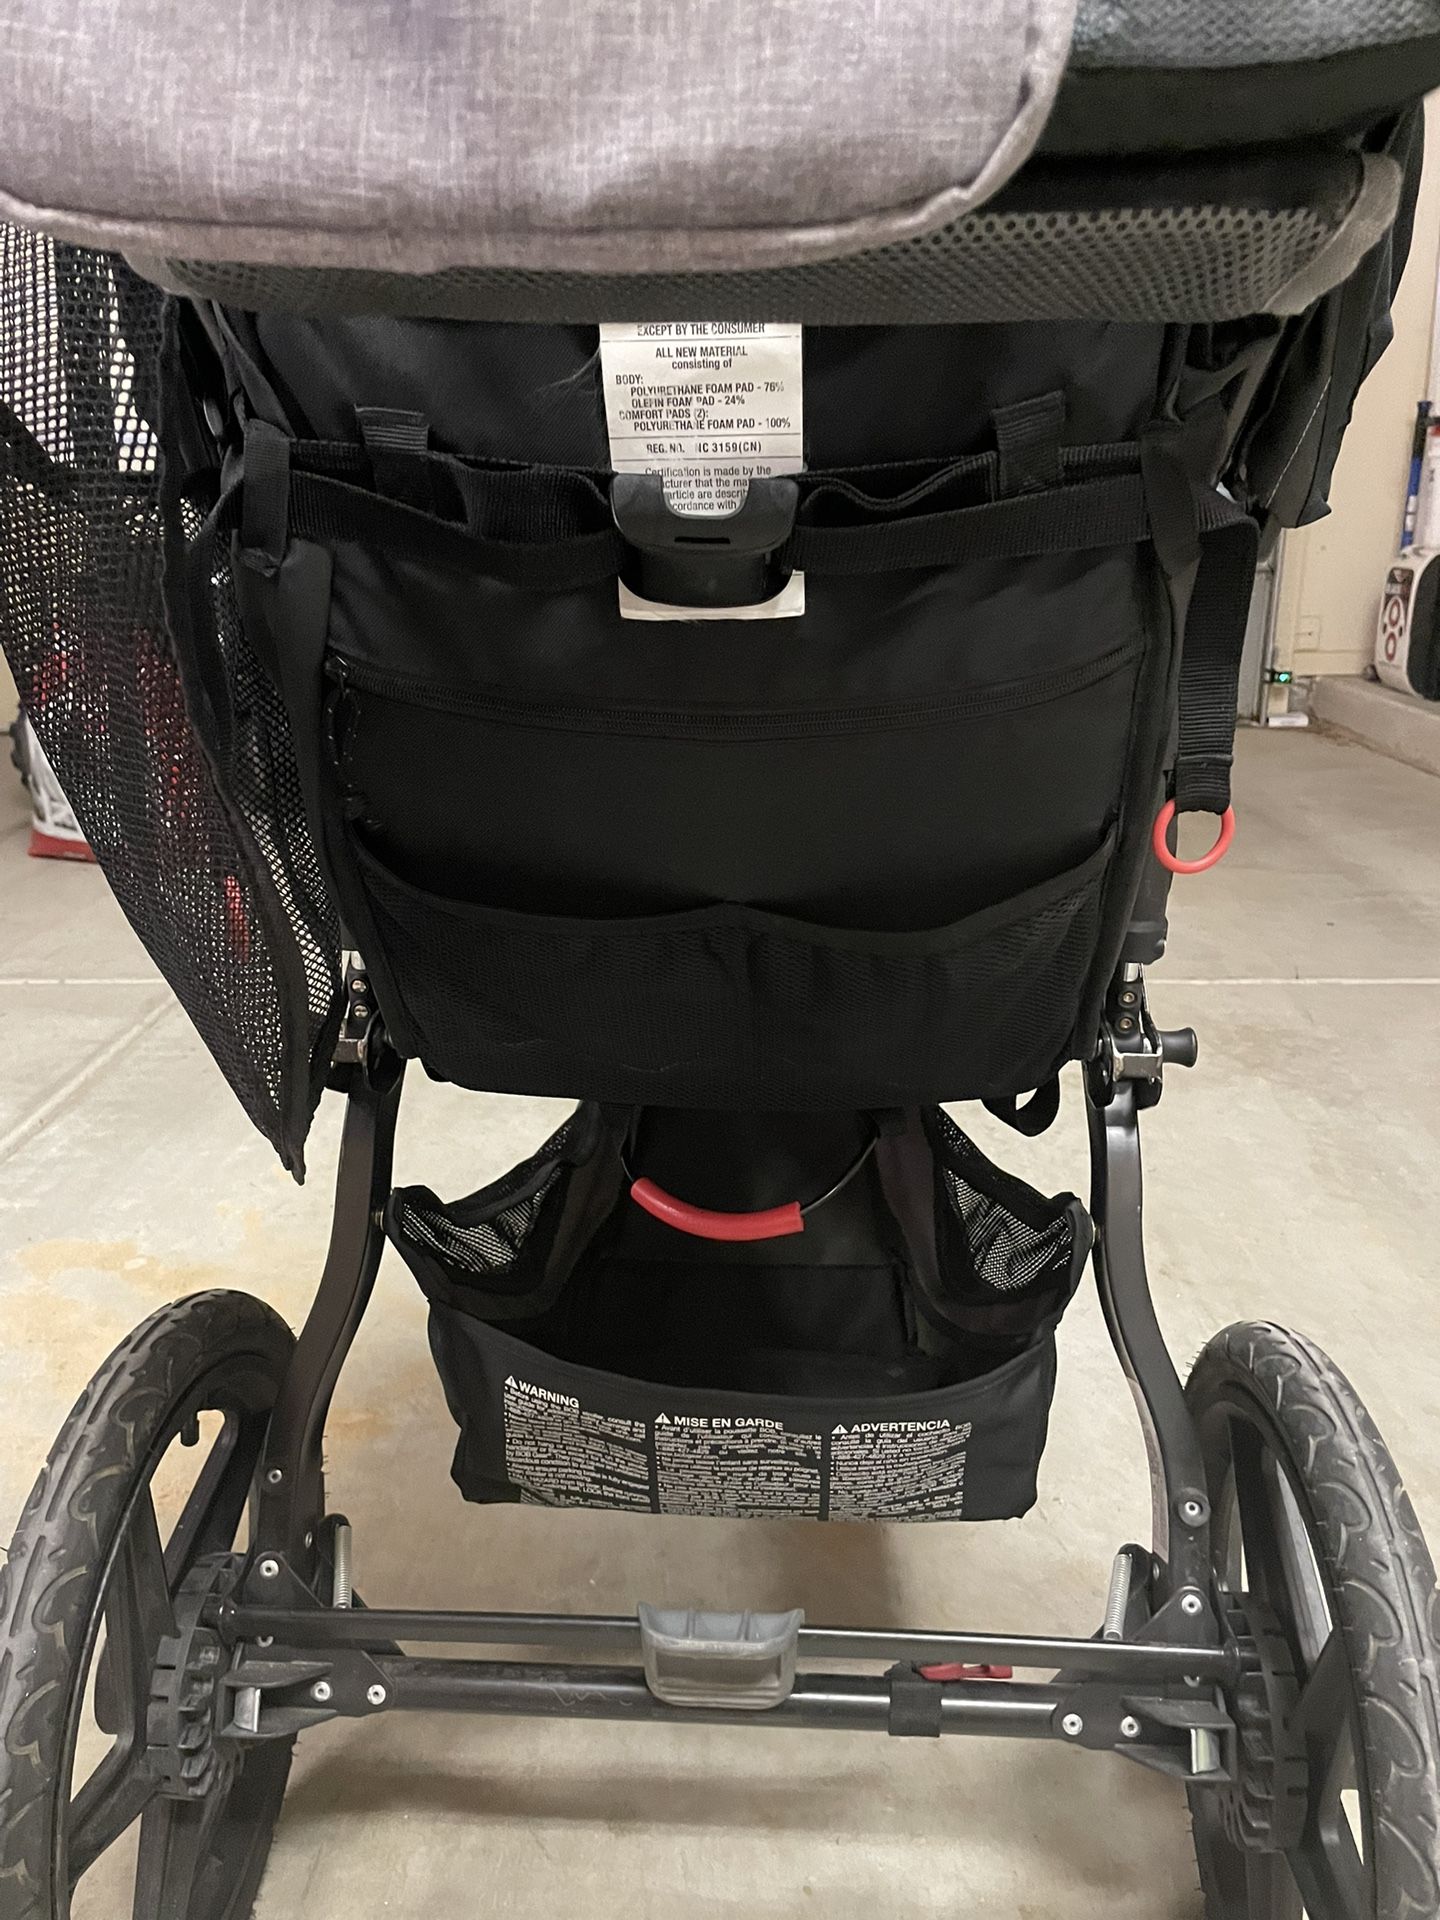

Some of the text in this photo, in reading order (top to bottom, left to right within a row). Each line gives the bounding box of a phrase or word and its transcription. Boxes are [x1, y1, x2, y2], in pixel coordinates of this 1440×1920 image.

[637, 322, 765, 336] EXCEPT BY THE CONSUMER
[656, 345, 748, 358] ALL NEW MATERIAL
[672, 358, 732, 371] consisting of
[615, 374, 644, 385] BODY:
[631, 383, 703, 397] POLYURETHANE
[705, 382, 733, 394] FOAM
[735, 381, 754, 393] PAD
[764, 381, 785, 392] 76%
[632, 397, 664, 408] OLEFIN
[724, 394, 745, 406] 24%
[619, 409, 663, 420] COMFORT
[666, 408, 691, 419] PADS
[707, 418, 734, 430] FOAM
[737, 418, 755, 429] PAD
[766, 417, 791, 428] 100%
[647, 442, 668, 454] REG.
[712, 440, 761, 454] 3159(CN)
[704, 466, 711, 476] is
[714, 466, 739, 476] made
[743, 465, 753, 478] by
[756, 465, 771, 475] the
[695, 478, 713, 488] that
[716, 477, 731, 487] the
[698, 490, 712, 499] are
[717, 500, 737, 510] with
[519, 1380, 579, 1409] WARNING
[674, 1416, 783, 1431] MISE EN GARDE
[851, 1419, 950, 1433] ADVERTENCIA
